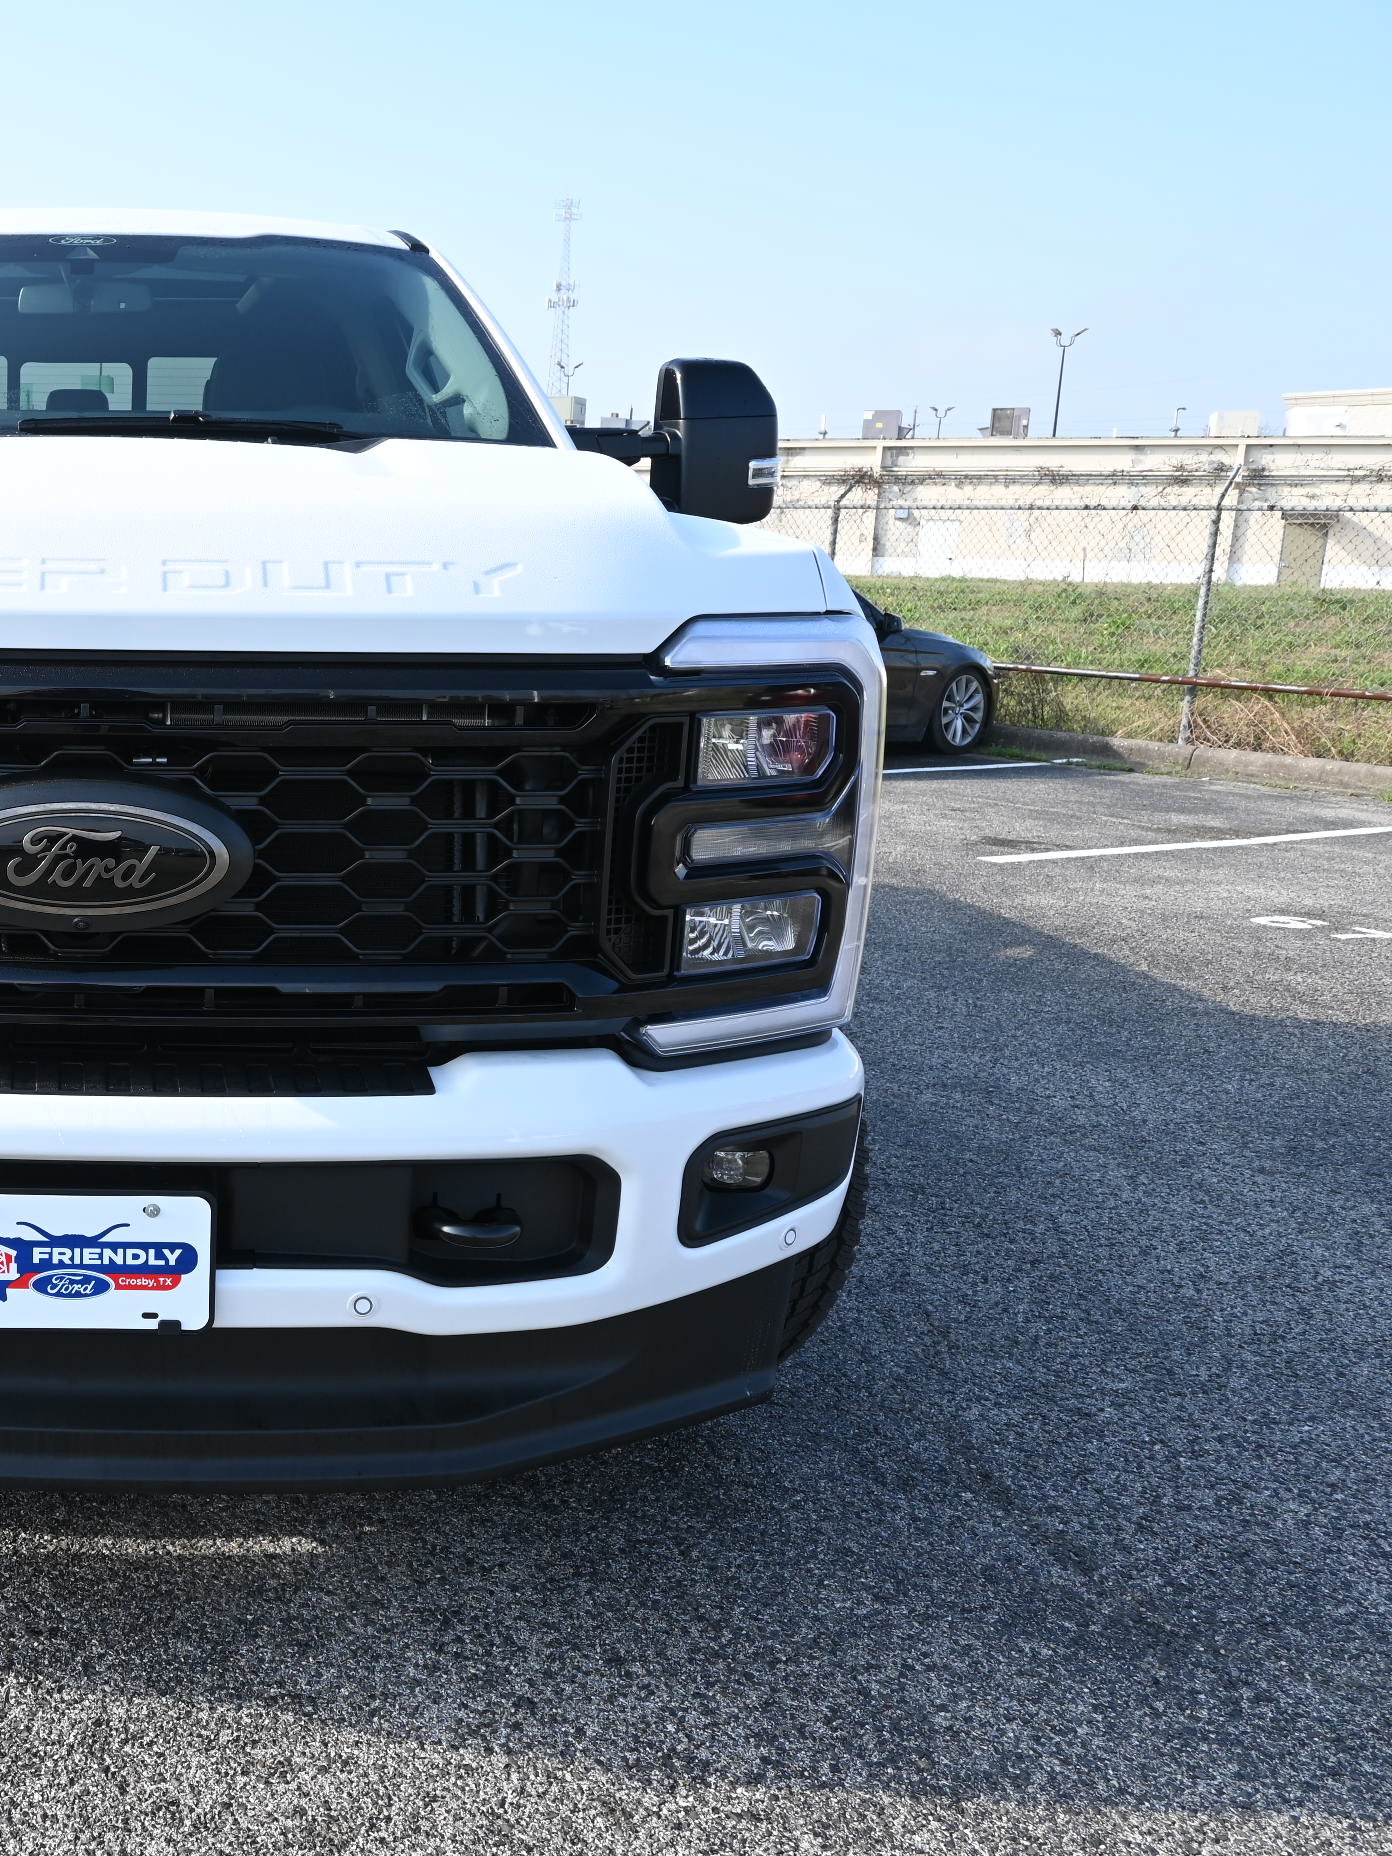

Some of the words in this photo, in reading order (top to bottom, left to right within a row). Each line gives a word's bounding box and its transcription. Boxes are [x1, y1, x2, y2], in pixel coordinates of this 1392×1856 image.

[161, 558, 525, 598] DUTY
[7, 826, 161, 889] Ford
[32, 1246, 183, 1266] FRIENDLY
[46, 1274, 96, 1294] Ford
[118, 1277, 157, 1287] Crosby,
[159, 1277, 173, 1286] TX
